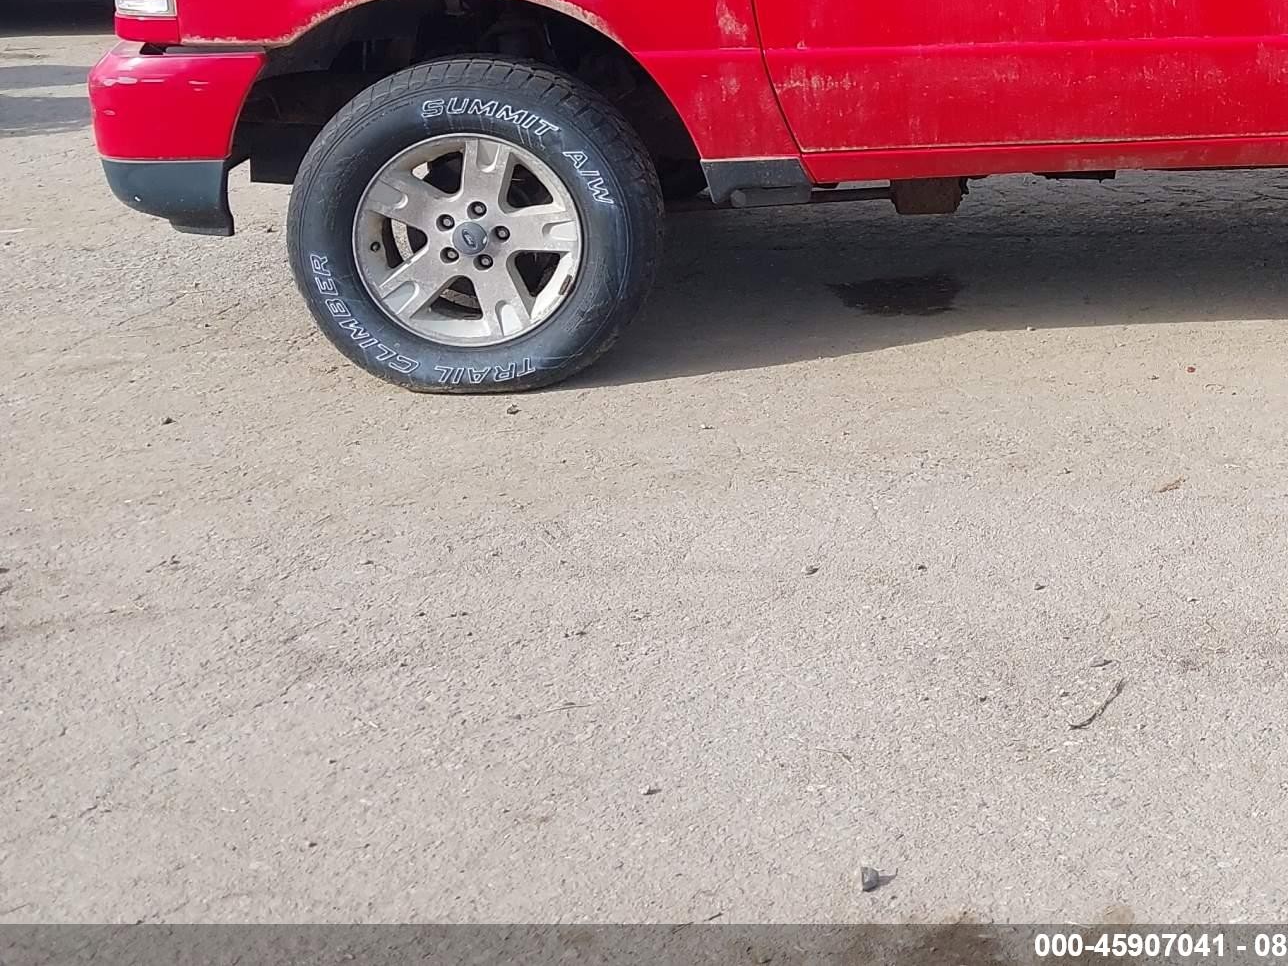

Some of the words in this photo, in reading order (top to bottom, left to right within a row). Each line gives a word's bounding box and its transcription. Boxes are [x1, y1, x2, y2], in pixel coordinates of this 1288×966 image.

[420, 97, 561, 136] SUMMIT
[309, 253, 420, 375] CLIMBER
[434, 357, 537, 384] TRAIL
